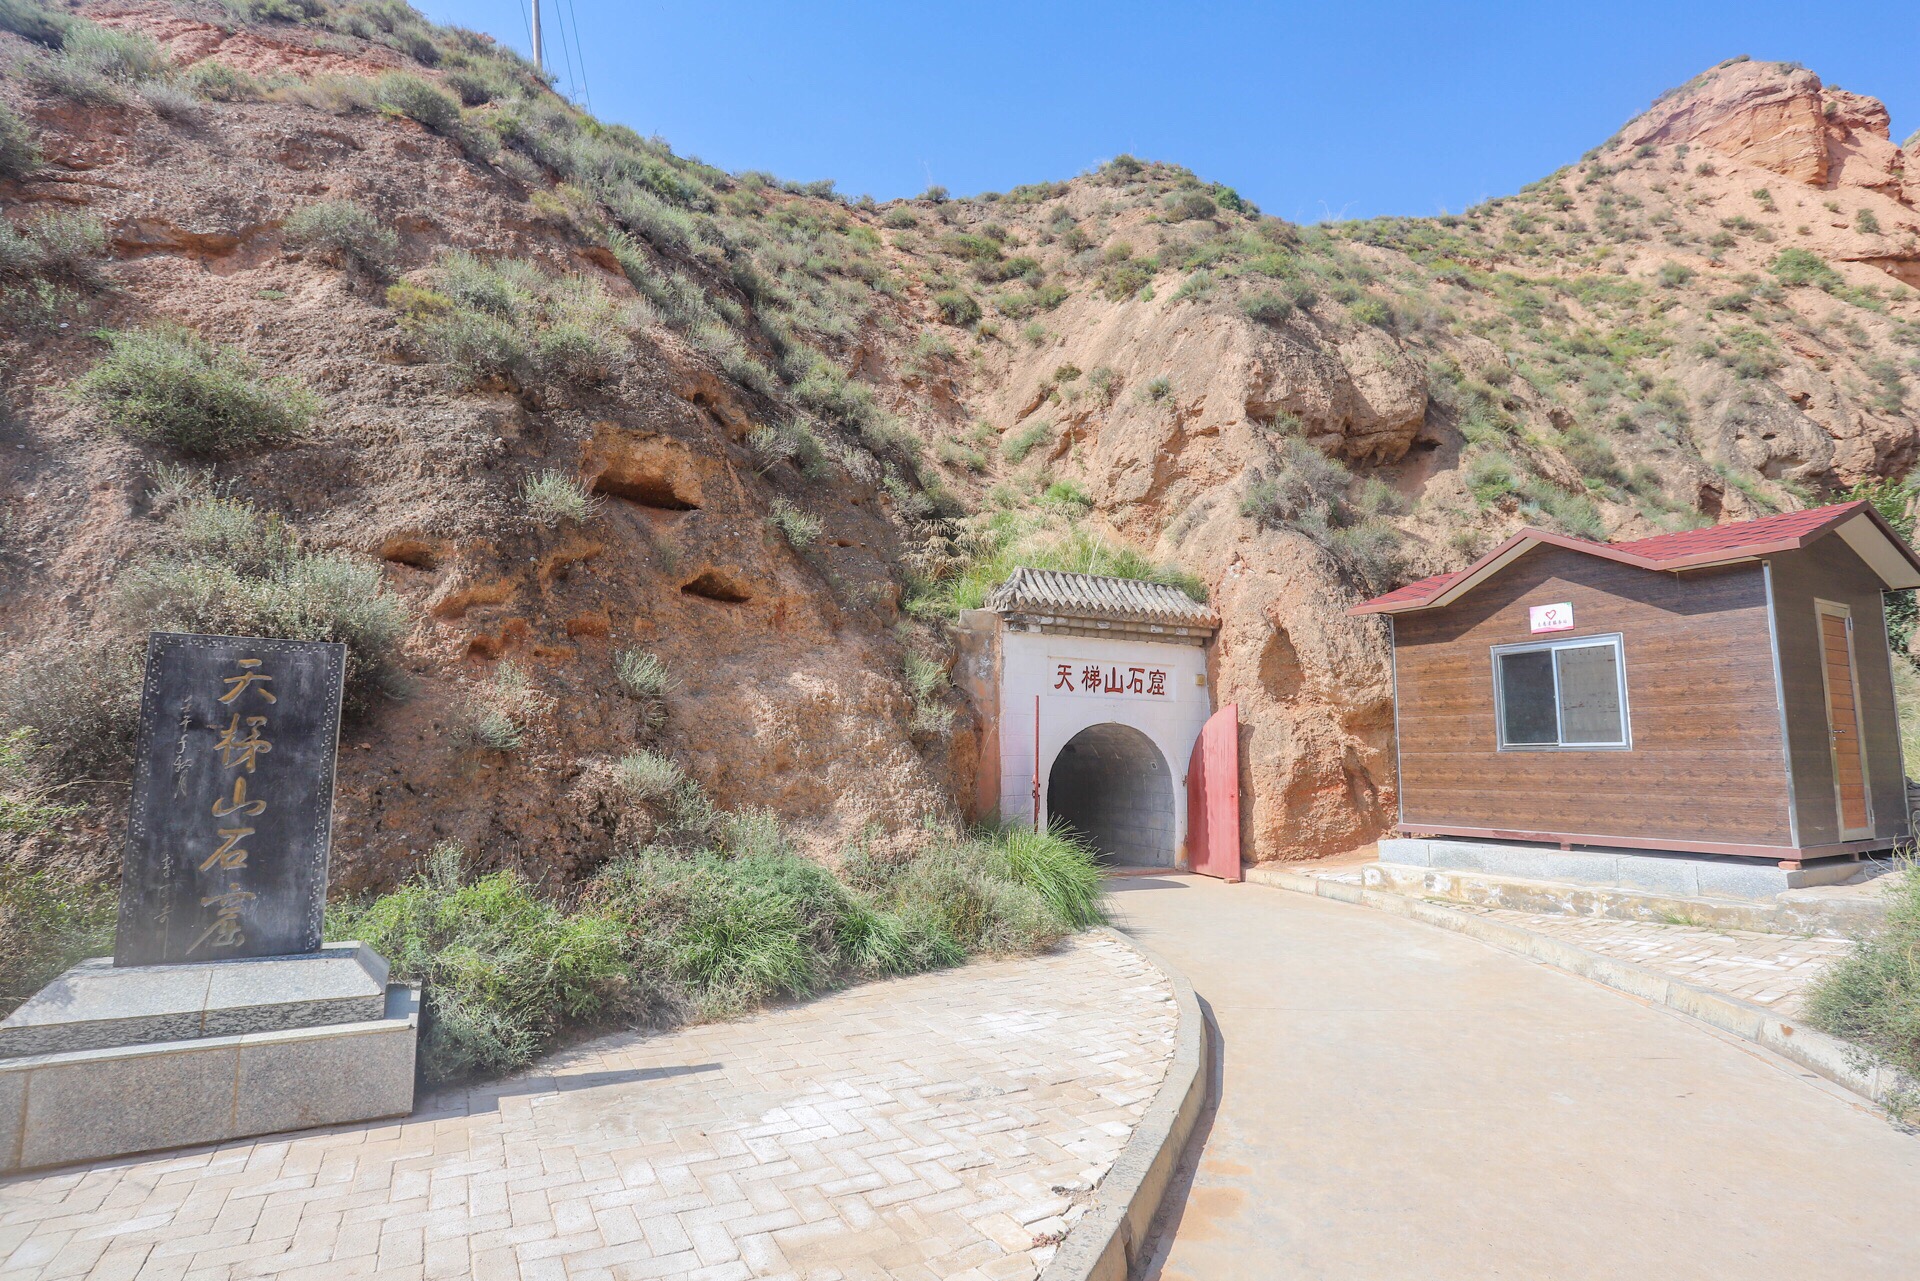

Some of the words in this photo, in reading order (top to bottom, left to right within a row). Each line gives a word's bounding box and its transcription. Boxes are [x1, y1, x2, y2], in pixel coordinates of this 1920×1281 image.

[1054, 664, 1167, 696] 天梯山石窟
[185, 658, 278, 956] 天梯山石窟
